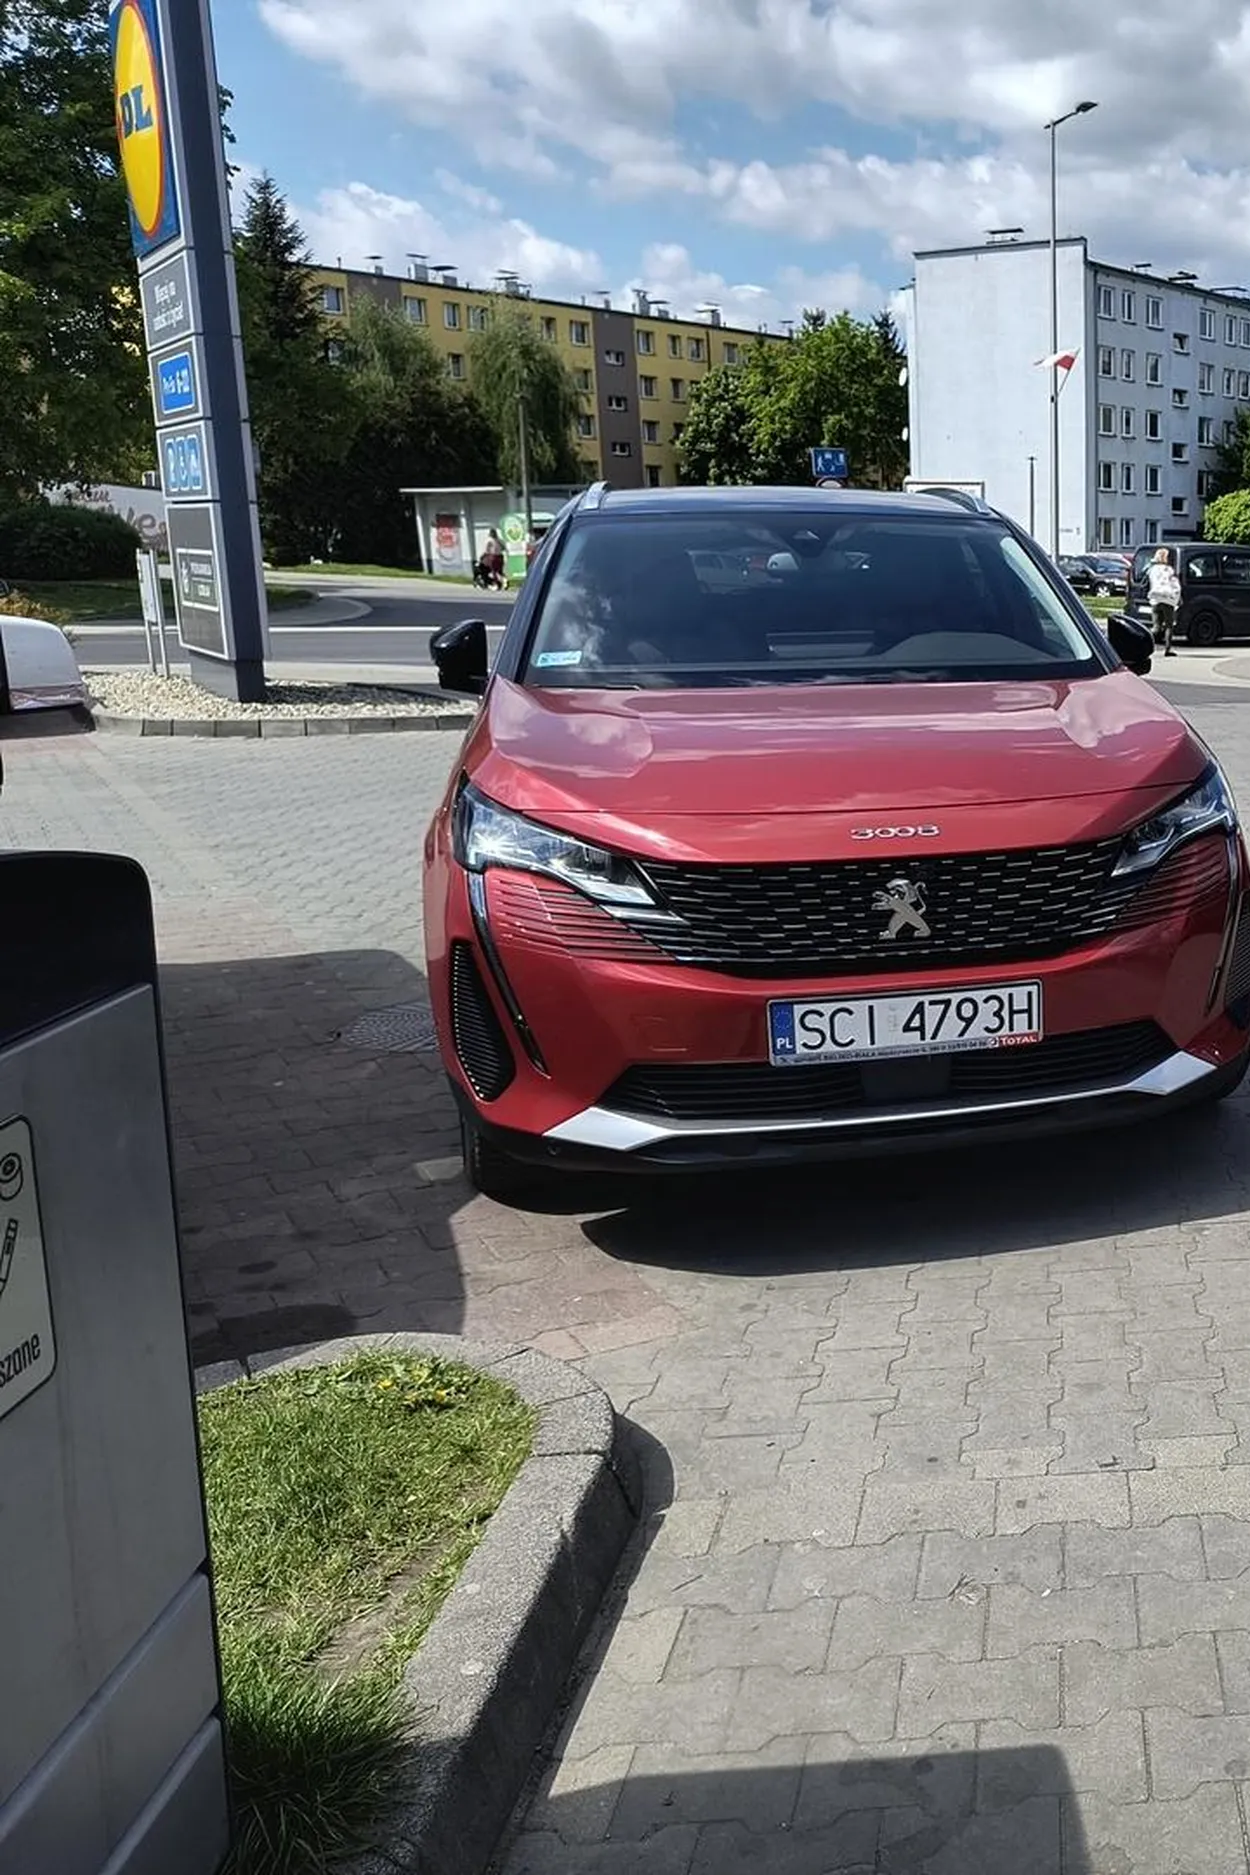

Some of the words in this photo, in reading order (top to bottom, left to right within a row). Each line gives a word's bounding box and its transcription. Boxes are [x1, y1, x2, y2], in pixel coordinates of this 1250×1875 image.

[851, 825, 939, 839] 3008
[799, 1004, 876, 1050] SCI
[902, 991, 1033, 1041] 4793H
[776, 1038, 792, 1049] PL
[1001, 1036, 1036, 1046] TOTAL
